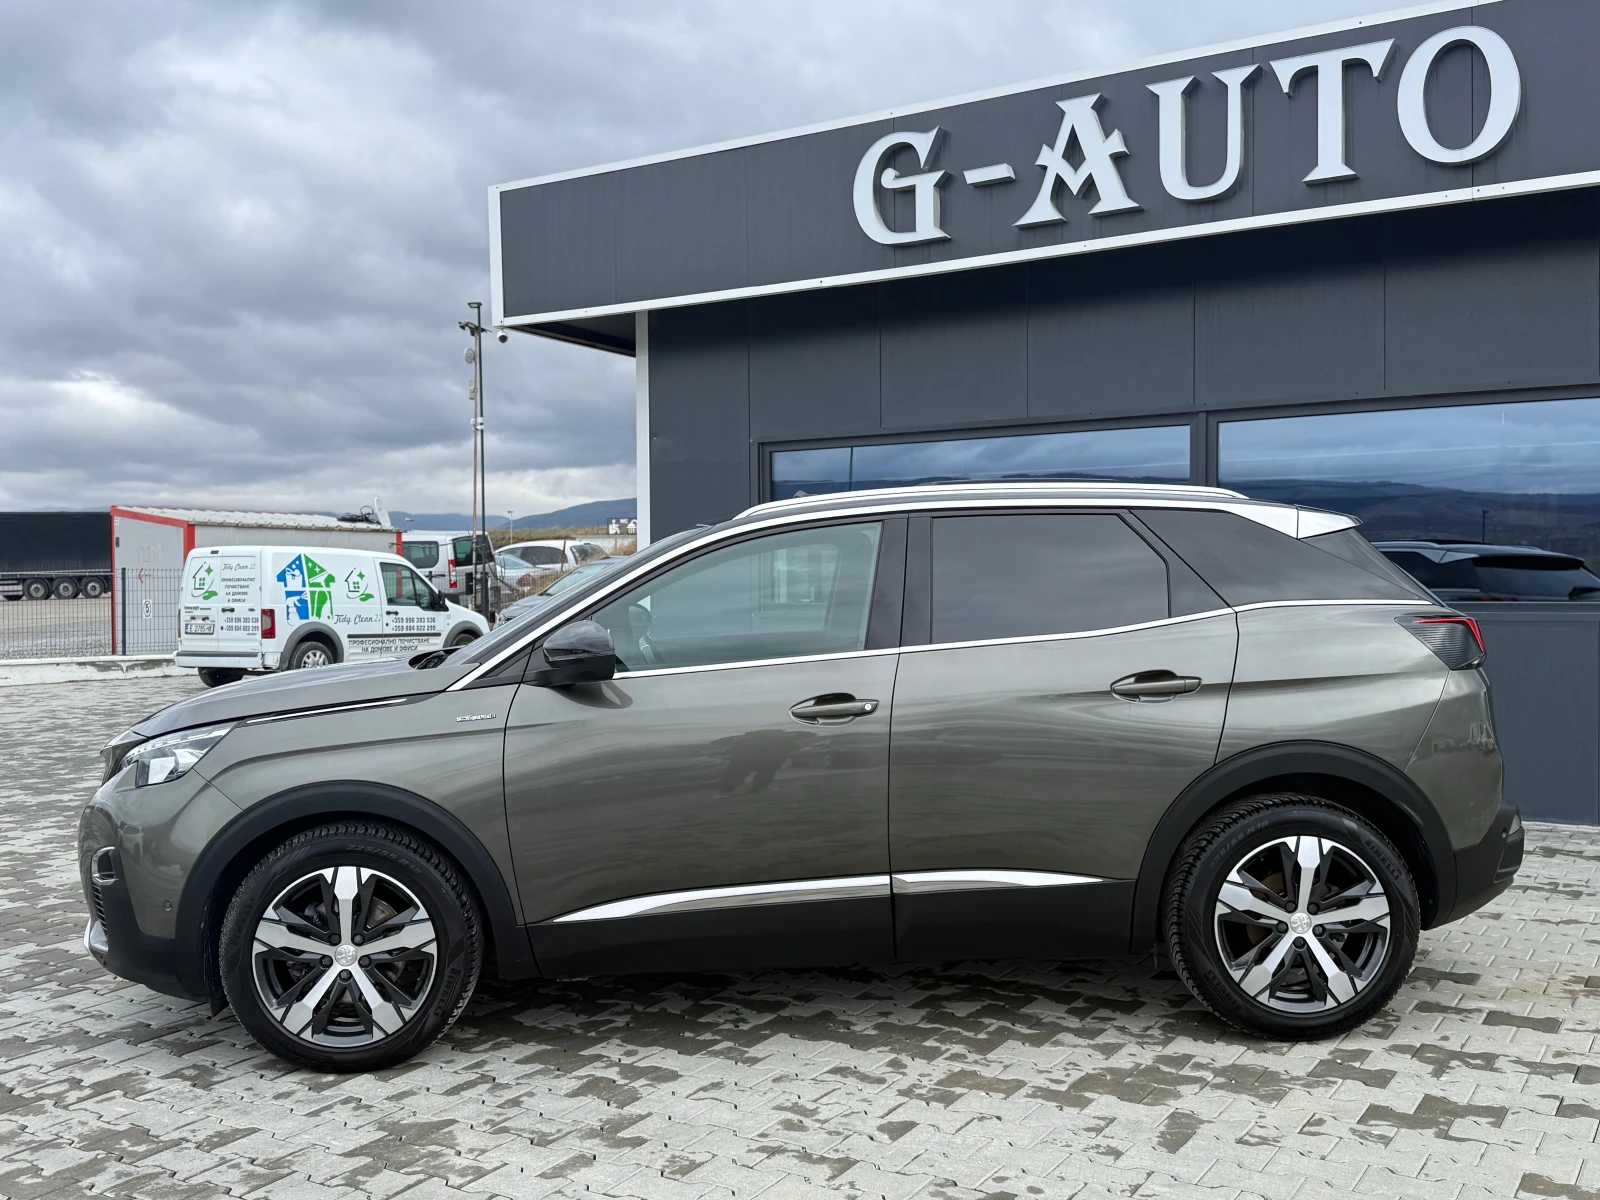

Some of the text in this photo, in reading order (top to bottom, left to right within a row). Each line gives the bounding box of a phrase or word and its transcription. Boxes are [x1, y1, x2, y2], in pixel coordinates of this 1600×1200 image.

[852, 24, 1522, 246] G-AUTO
[353, 613, 373, 625] Clean
[348, 638, 397, 646] ПРОФЕСИОНАЛНО
[346, 844, 422, 874] 225/55 R18
[1365, 839, 1401, 880] PIRELLI
[433, 968, 461, 1016] PIRELLI
